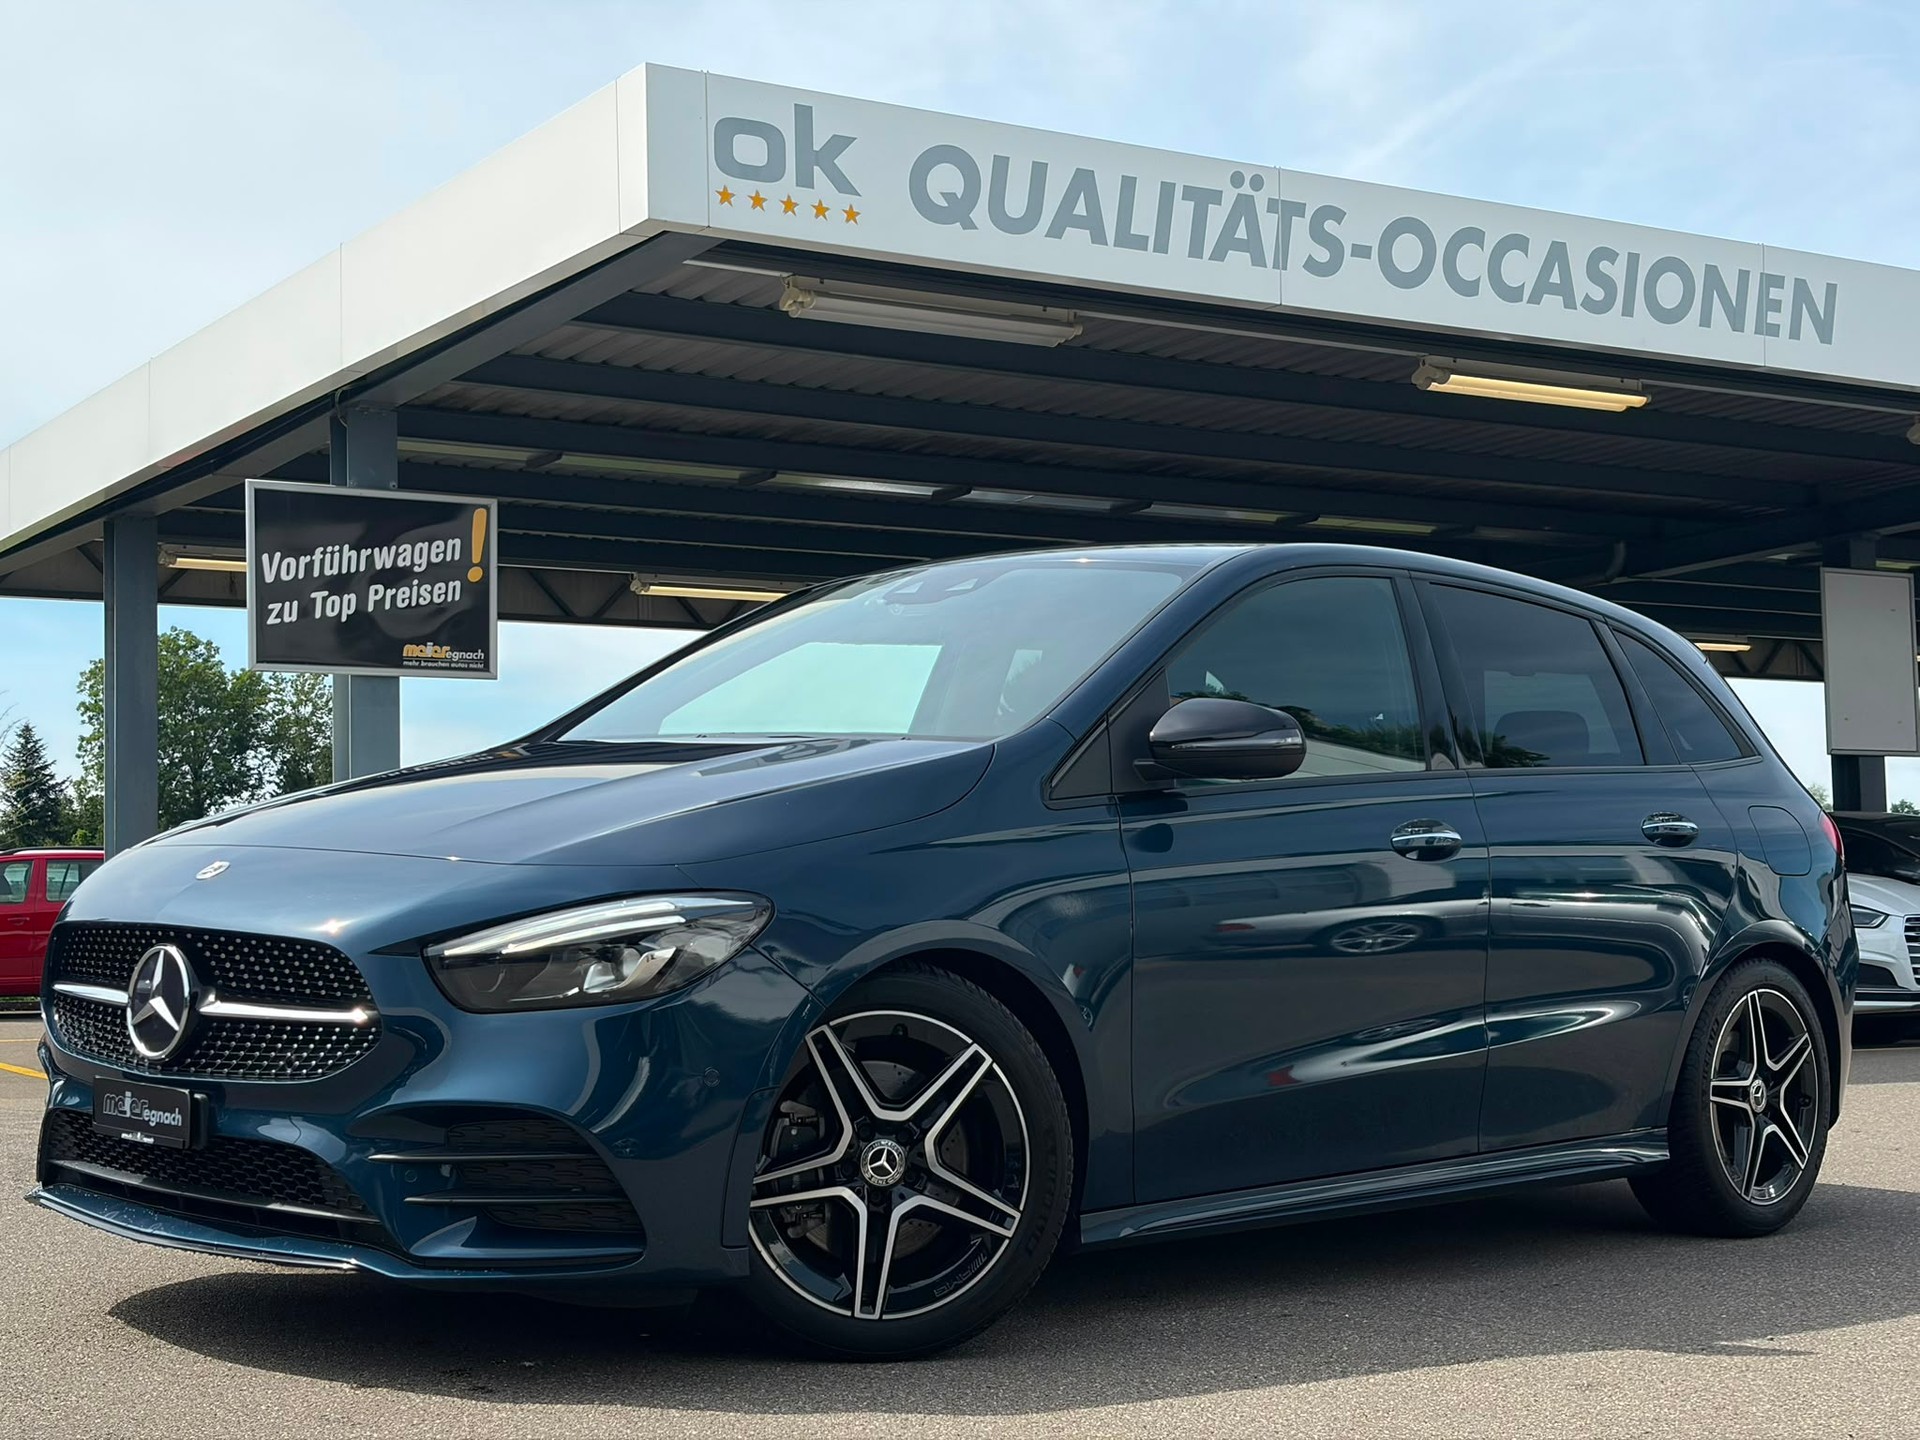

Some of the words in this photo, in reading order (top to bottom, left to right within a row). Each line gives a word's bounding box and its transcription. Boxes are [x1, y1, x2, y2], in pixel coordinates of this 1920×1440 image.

[713, 103, 862, 197] ok
[909, 144, 1838, 345] QUALITÄTS-OCCASIONEN
[261, 537, 461, 584] Vorführwagen
[266, 600, 299, 625] zu
[310, 590, 357, 622] Top
[367, 579, 461, 612] Preisen
[421, 660, 449, 668] brauchen
